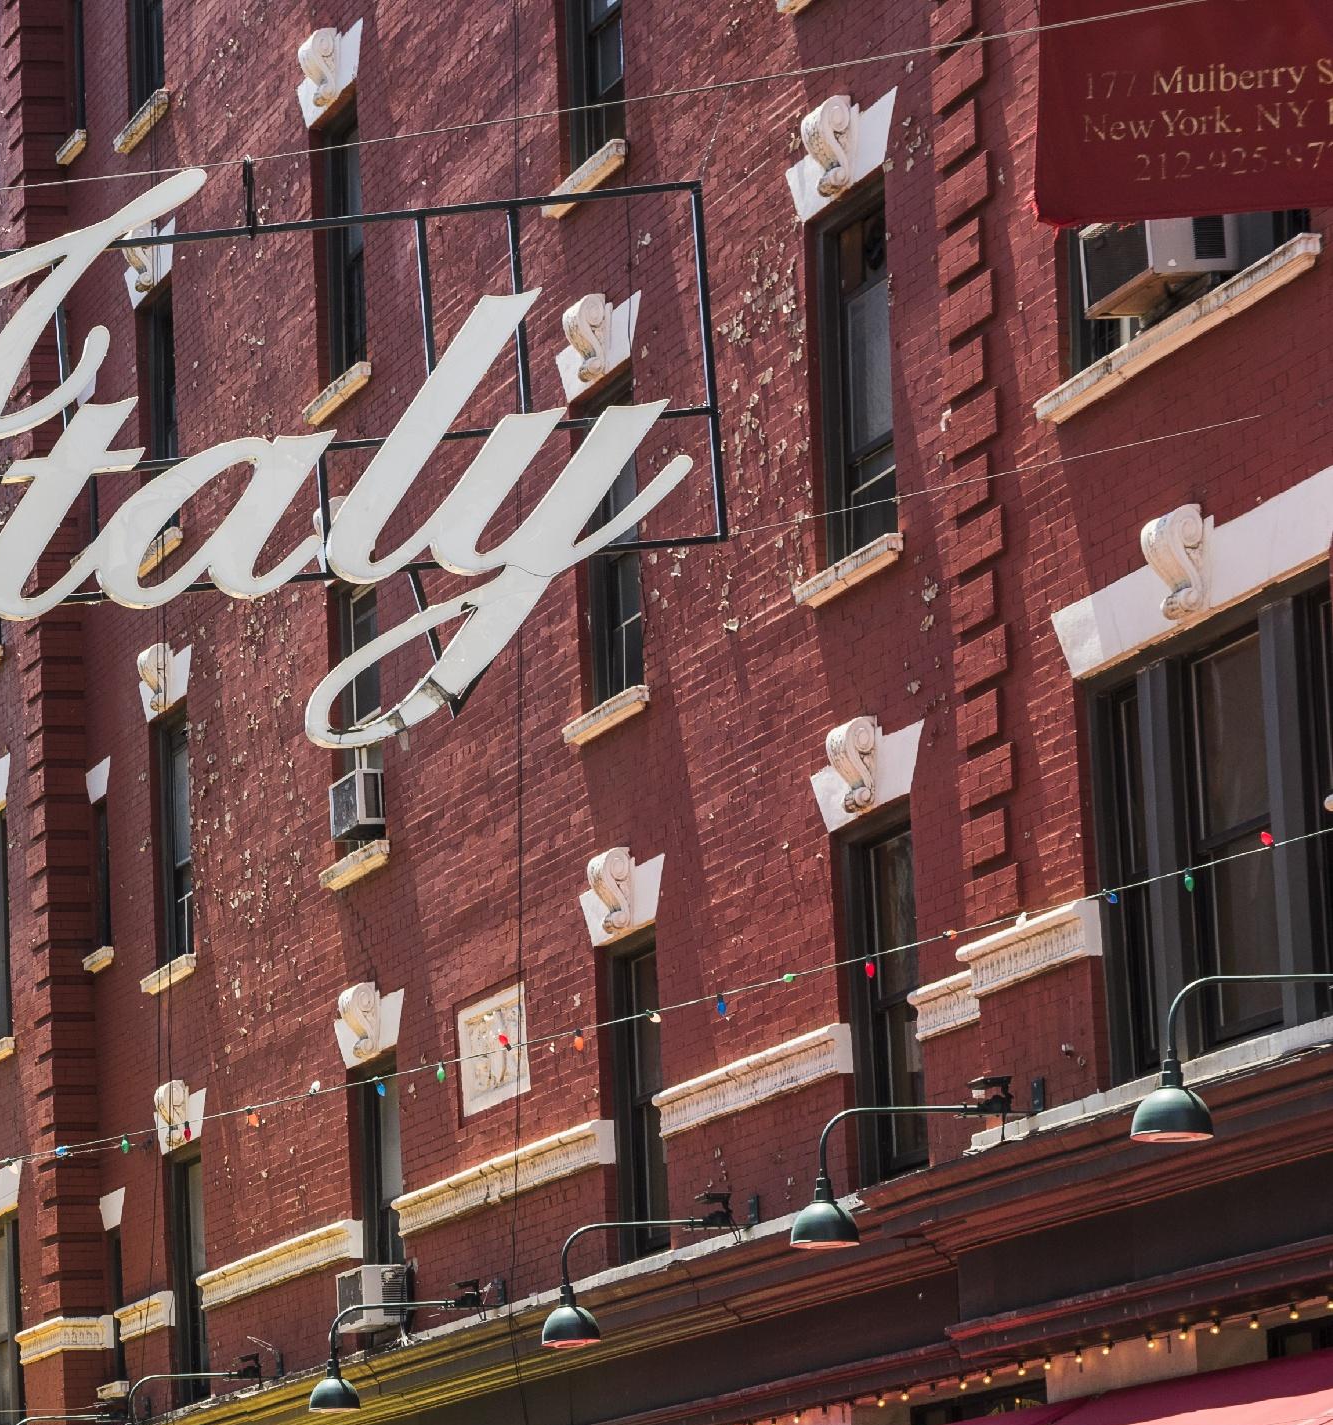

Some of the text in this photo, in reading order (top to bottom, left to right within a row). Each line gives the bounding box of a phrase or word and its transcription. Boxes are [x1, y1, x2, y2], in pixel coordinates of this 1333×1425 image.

[1151, 63, 1307, 95] Mulberry
[1083, 113, 1155, 143] New
[1256, 100, 1313, 132] NY
